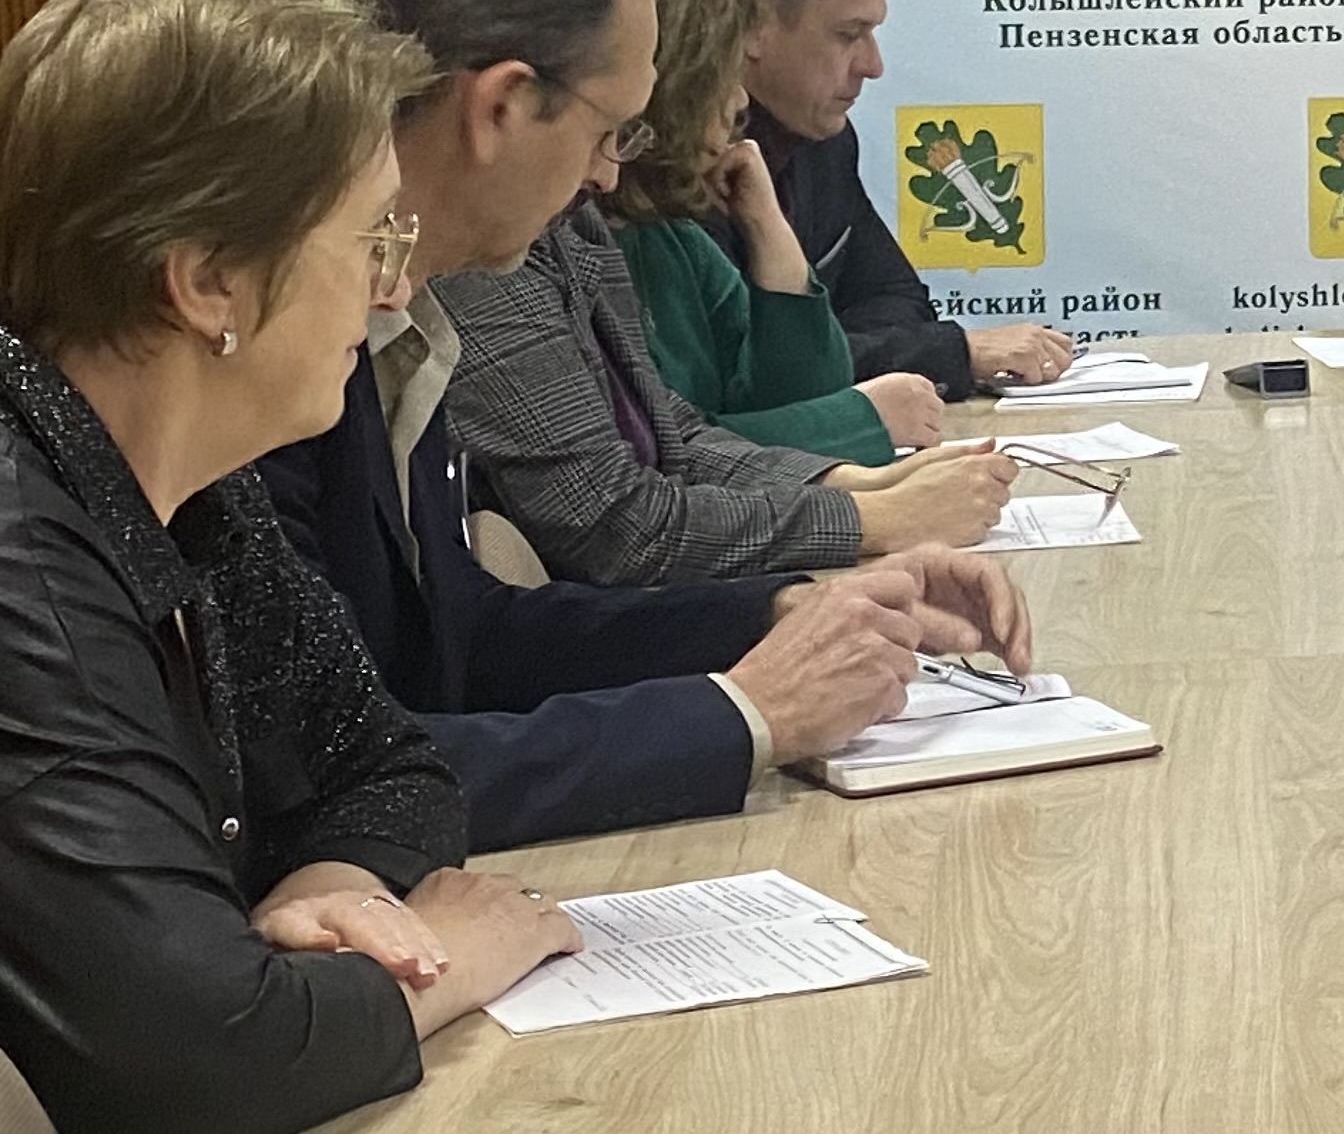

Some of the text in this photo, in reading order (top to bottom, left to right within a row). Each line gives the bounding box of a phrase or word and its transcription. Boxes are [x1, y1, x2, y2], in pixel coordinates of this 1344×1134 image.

[998, 19, 1343, 48] Пензенская область
[928, 286, 1162, 320] ейский район
